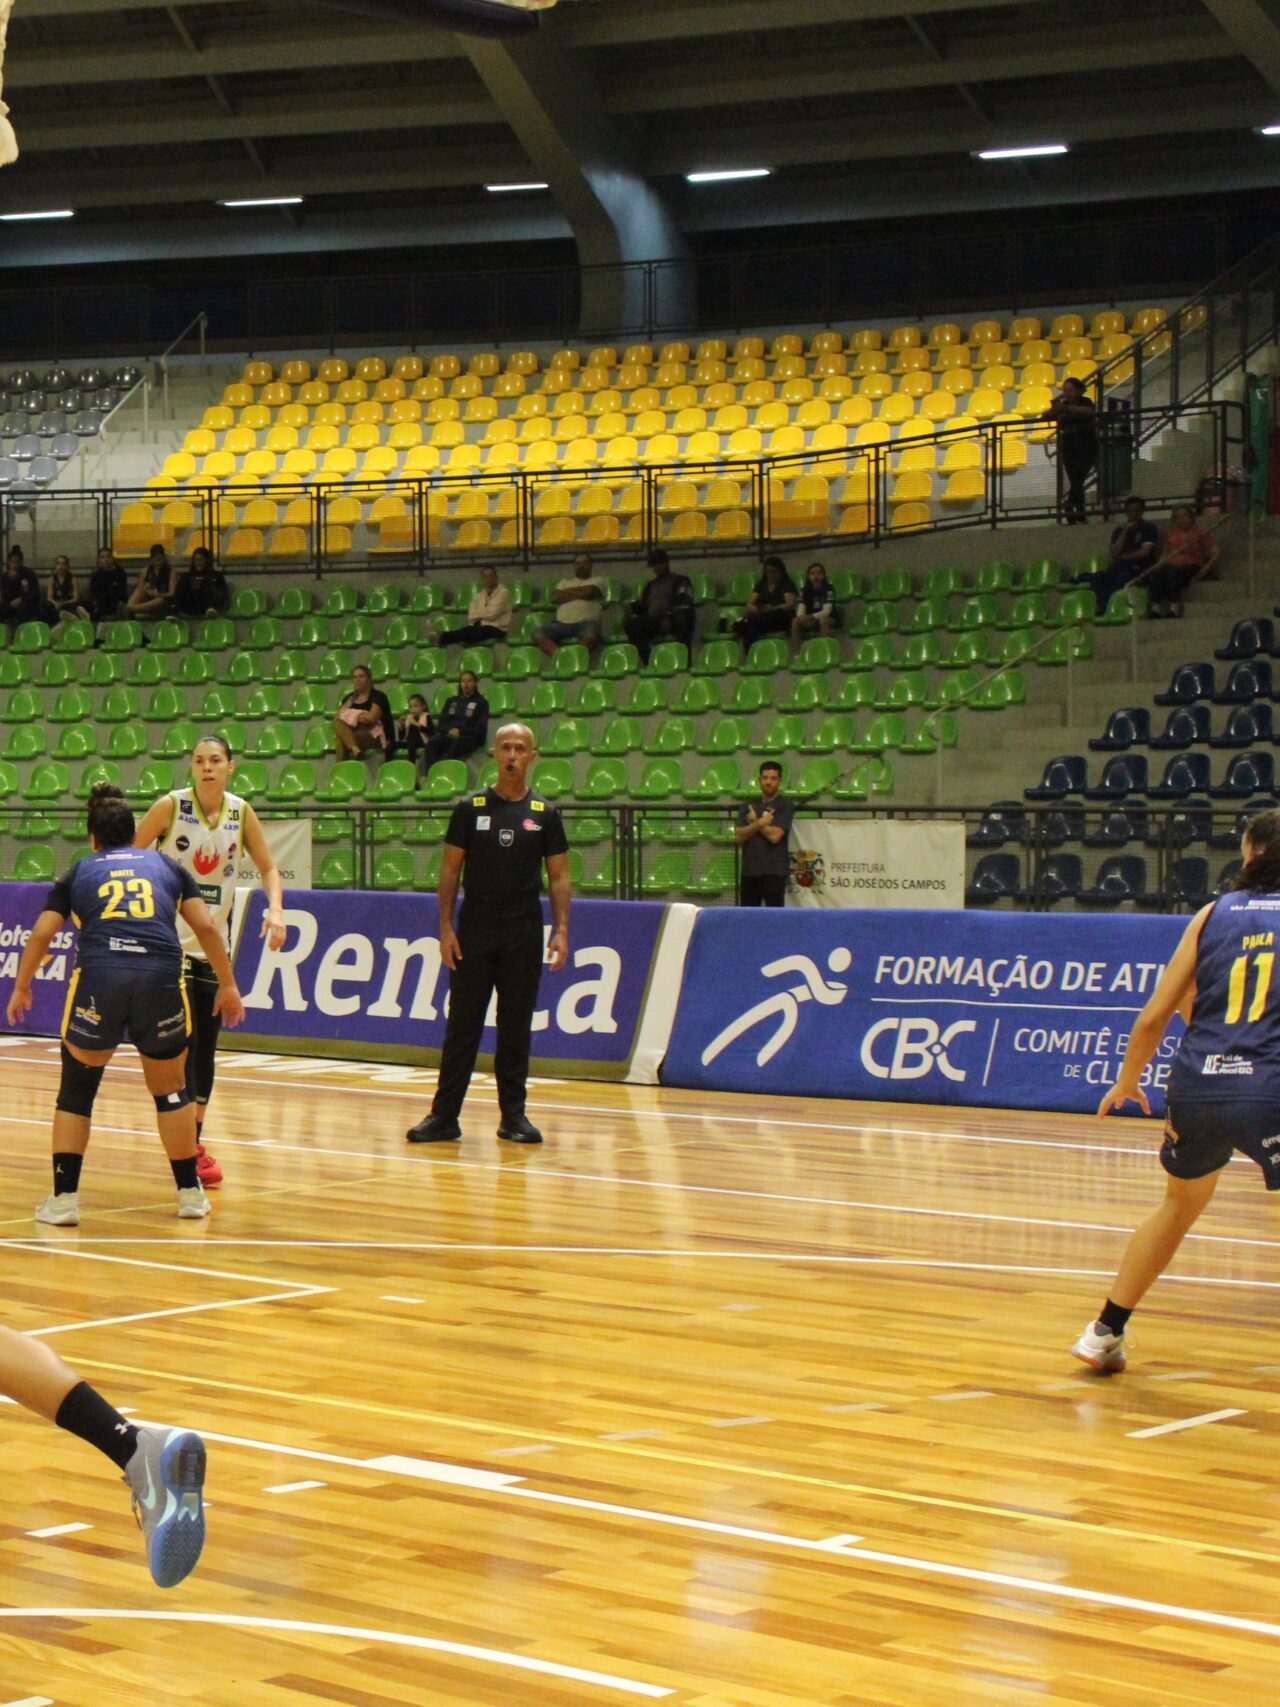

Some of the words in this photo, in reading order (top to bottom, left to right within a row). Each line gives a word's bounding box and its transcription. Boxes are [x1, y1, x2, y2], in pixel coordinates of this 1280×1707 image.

[830, 862, 885, 873] PREFEITURA
[830, 876, 850, 889] SÃO
[852, 877, 878, 889] JOSÉ
[879, 878, 899, 890] DOS
[903, 879, 946, 891] CAMPOS
[98, 879, 155, 919] 23
[874, 955, 1054, 997] FORMAÇÃO
[1060, 961, 1107, 992] DE
[1224, 952, 1276, 1024] 11
[860, 1017, 977, 1082] CBC
[1013, 1026, 1112, 1056] COMITÊ
[1063, 1064, 1082, 1078] DE
